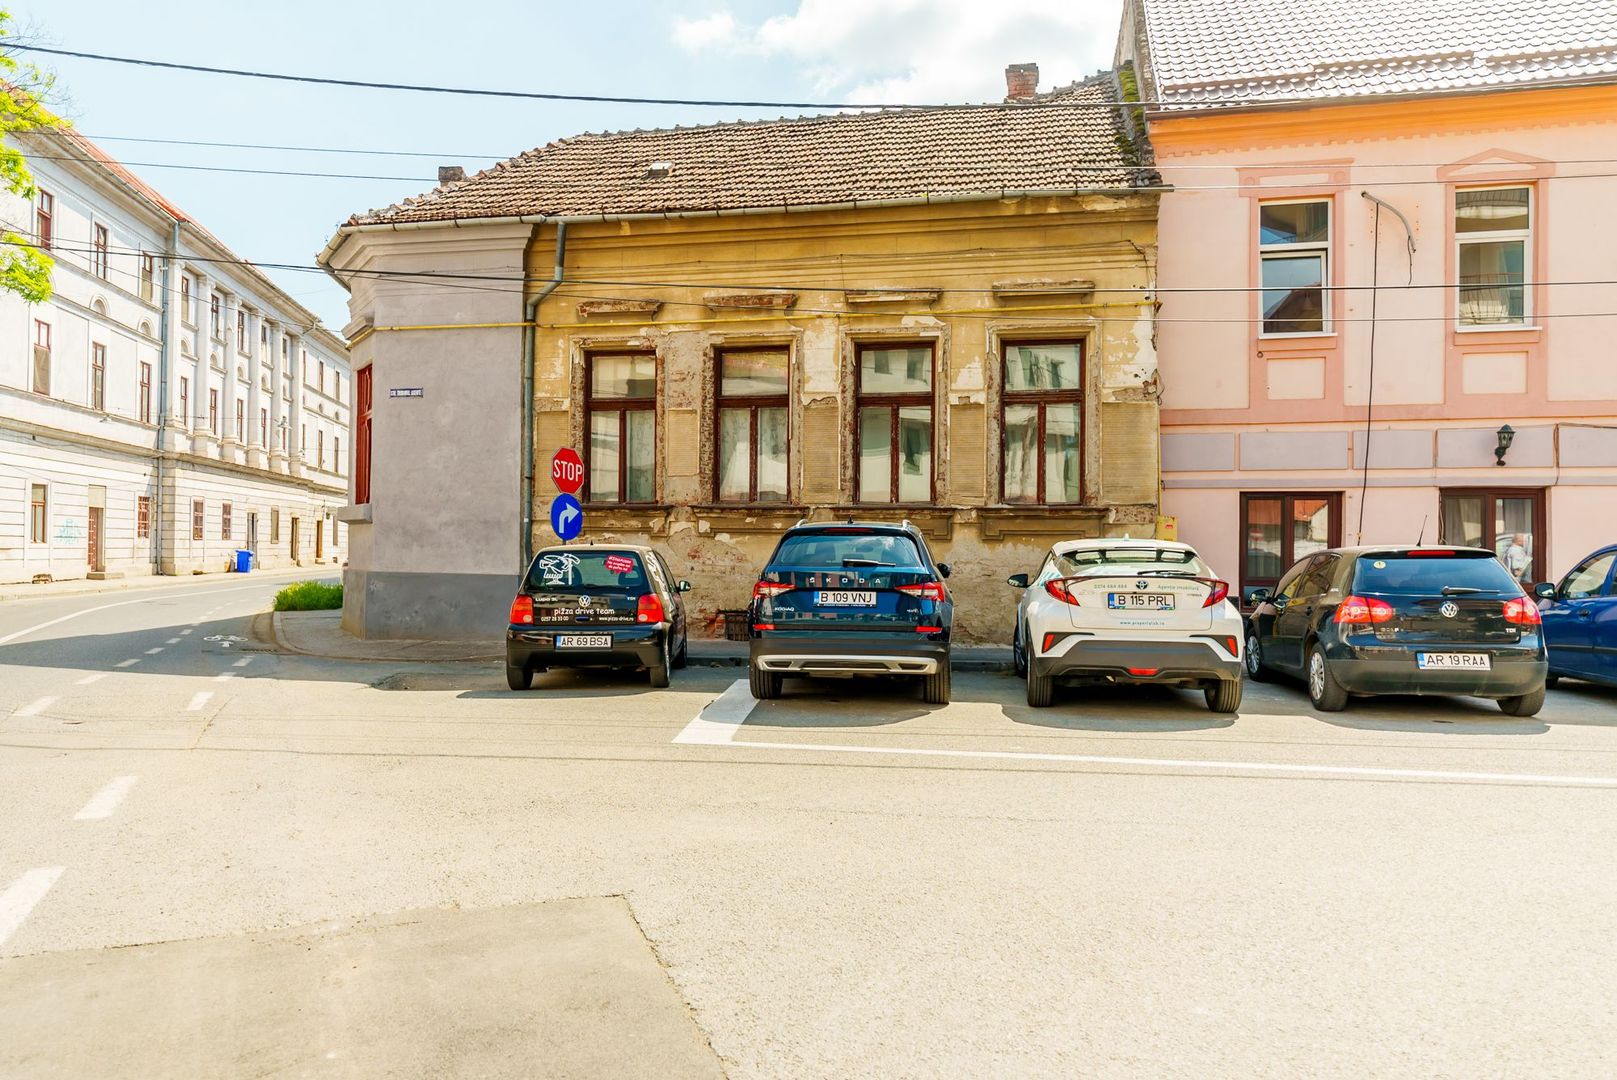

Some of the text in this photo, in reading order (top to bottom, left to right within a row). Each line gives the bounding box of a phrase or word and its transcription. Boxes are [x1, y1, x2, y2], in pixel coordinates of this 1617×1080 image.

[553, 459, 583, 482] STOP
[821, 593, 872, 602] B 109 VNJ
[1118, 595, 1170, 606] B 115 PRL
[554, 608, 574, 616] pizza
[575, 607, 594, 615] drive
[561, 637, 609, 646] AR 69 BSA
[1427, 655, 1486, 666] AR 19 RAA
